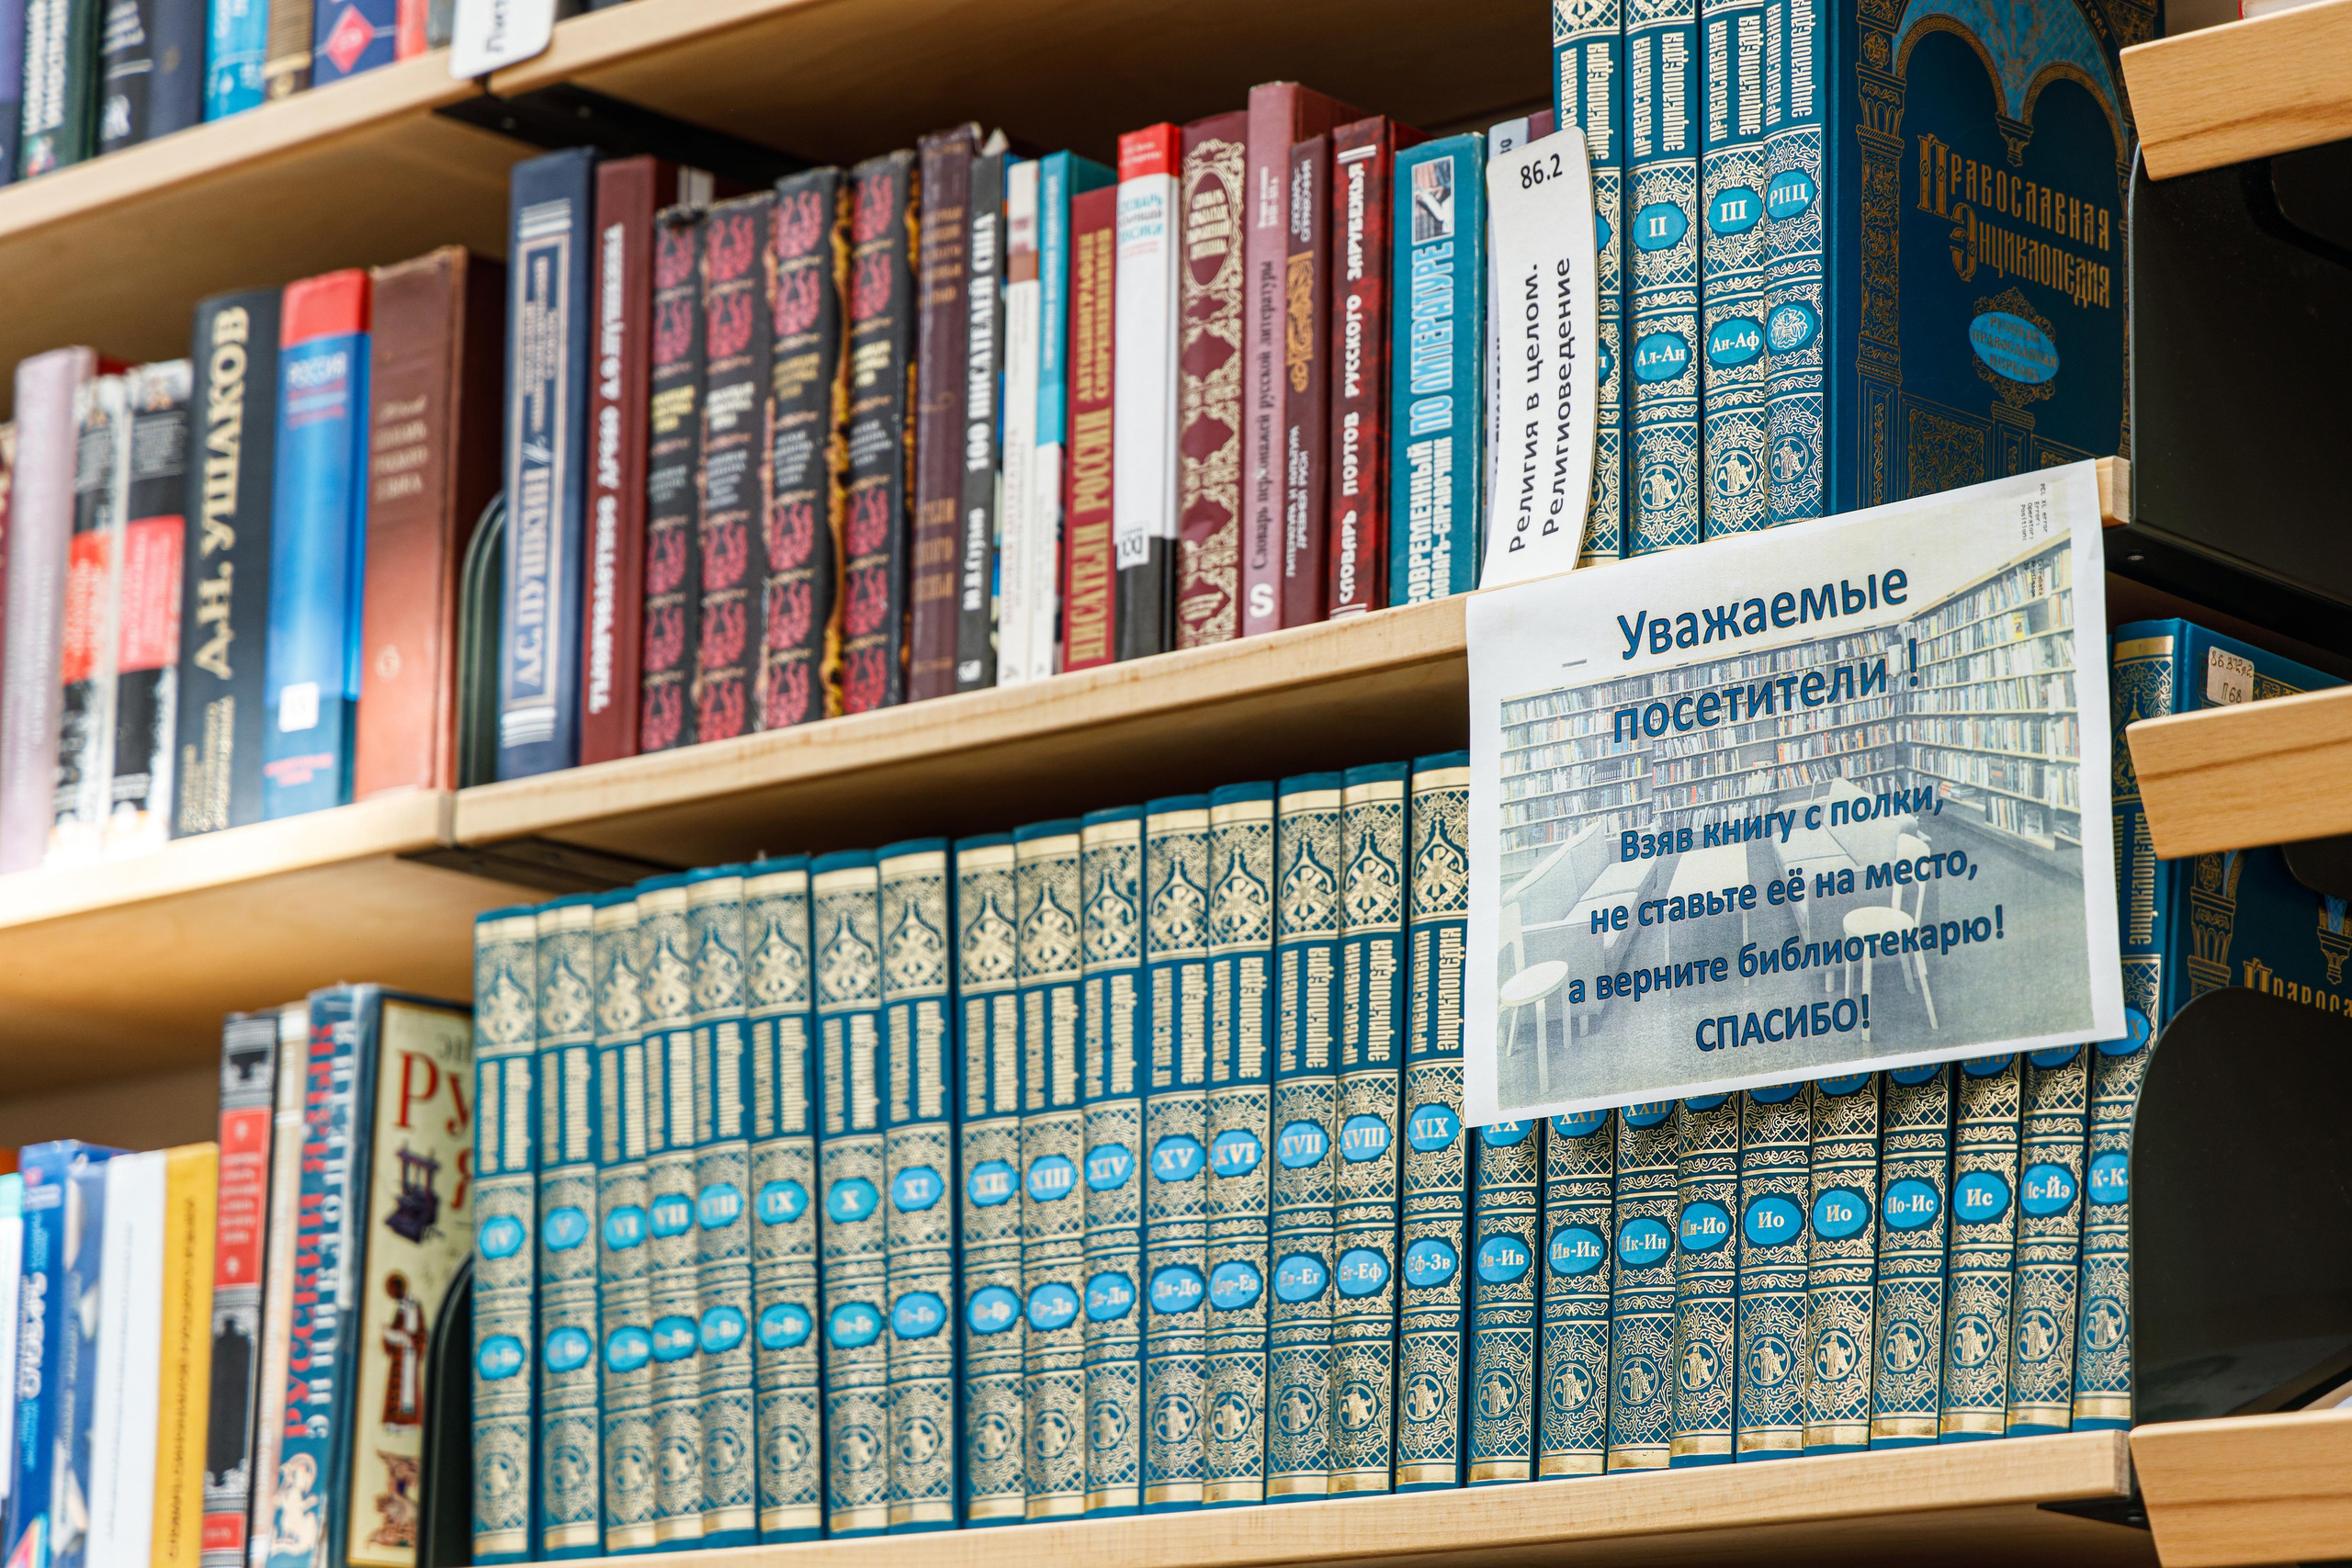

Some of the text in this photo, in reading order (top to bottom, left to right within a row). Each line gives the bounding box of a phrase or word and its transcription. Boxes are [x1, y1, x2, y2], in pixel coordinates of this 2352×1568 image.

[1561, 48, 1577, 129] ОСЛАВНАЯ
[1662, 32, 1689, 152] ЭНЦИКЛОПЕДИЯ
[1709, 20, 1727, 142] ПРАВОСЛАВНАЯ
[1738, 15, 1764, 136] ЭНЦИКЛОПЕДИЯ
[1766, 3, 1781, 127] ПРАВОСЛАВНАЯ
[1633, 37, 1652, 158] ПРАВОСЛАВНАЯ
[1521, 152, 1564, 190] 86.2
[1769, 180, 1809, 209] РПЦ
[1720, 199, 1747, 223] III
[1261, 260, 1275, 346] литературы
[967, 212, 996, 472] 100 ПИСАТЕЛЕЙ США
[1410, 241, 1454, 435] ПО ЛИТЕРАТУРЕ
[1636, 345, 1686, 368] Ал-Ан
[1712, 328, 1760, 355] Ан-Аф
[1259, 352, 1274, 411] русской
[1339, 163, 1363, 603] СЛОВАРЬ ПОЭТОВ РУССКОГО ЗАРУБЕЖЬЯ
[1509, 263, 1542, 554] Религия в целом.
[1542, 257, 1571, 540] Религиоведение
[202, 306, 249, 554] УШАКОВ
[1069, 409, 1111, 663] ПИСАТЕЛИ РОССИИ
[1251, 511, 1270, 570] Словарь
[1430, 436, 1453, 597] ЛОВАРЬ-СПРАВОЧНИК
[1617, 567, 1909, 660] Уважаемые
[1612, 637, 1919, 744] посетители !
[1620, 781, 1944, 864] Взяв книгу с полки,
[1590, 848, 1978, 935] не ставьте её на место,
[1568, 904, 2005, 1005] а верните библиотекарю!
[1342, 942, 1361, 1066] ПРАВОСЛАВНАЯ
[1368, 939, 1397, 1062] ЭНЦИКЛОПЕДИЯ
[1411, 931, 1430, 1054] ПРАВОСЛАВНАЯ
[1437, 928, 1464, 1051] ЭНЦИКЛОПЕДИЯ
[1695, 994, 1871, 1053] СПАСИБО!
[1214, 1142, 1256, 1167] XVI
[1281, 1134, 1322, 1157] XVII
[1342, 1126, 1385, 1150] XVIII
[1414, 1117, 1450, 1140] XIX
[1089, 1156, 1129, 1180] XIV
[1158, 1147, 1195, 1170] XV
[2092, 1168, 2129, 1189] К-К
[841, 1189, 860, 1212] X
[1826, 1204, 1852, 1223] Ио
[1887, 1194, 1935, 1213] Ио-Ис
[1966, 1189, 1994, 1207] Ис
[2023, 1176, 2071, 1201] Ис-Йэ
[284, 1022, 334, 1438] РУССКИЙ ЯЗЫК
[1621, 1234, 1668, 1252] Ик-Ин
[1681, 1215, 1727, 1236] Ин-Ио
[1757, 1211, 1785, 1229] Ио
[1340, 1262, 1382, 1285] Ег-Еф
[1408, 1255, 1451, 1273] Еф-Зв
[1479, 1250, 1525, 1269] Зв-Ив
[1552, 1241, 1601, 1260] Ив-Ик
